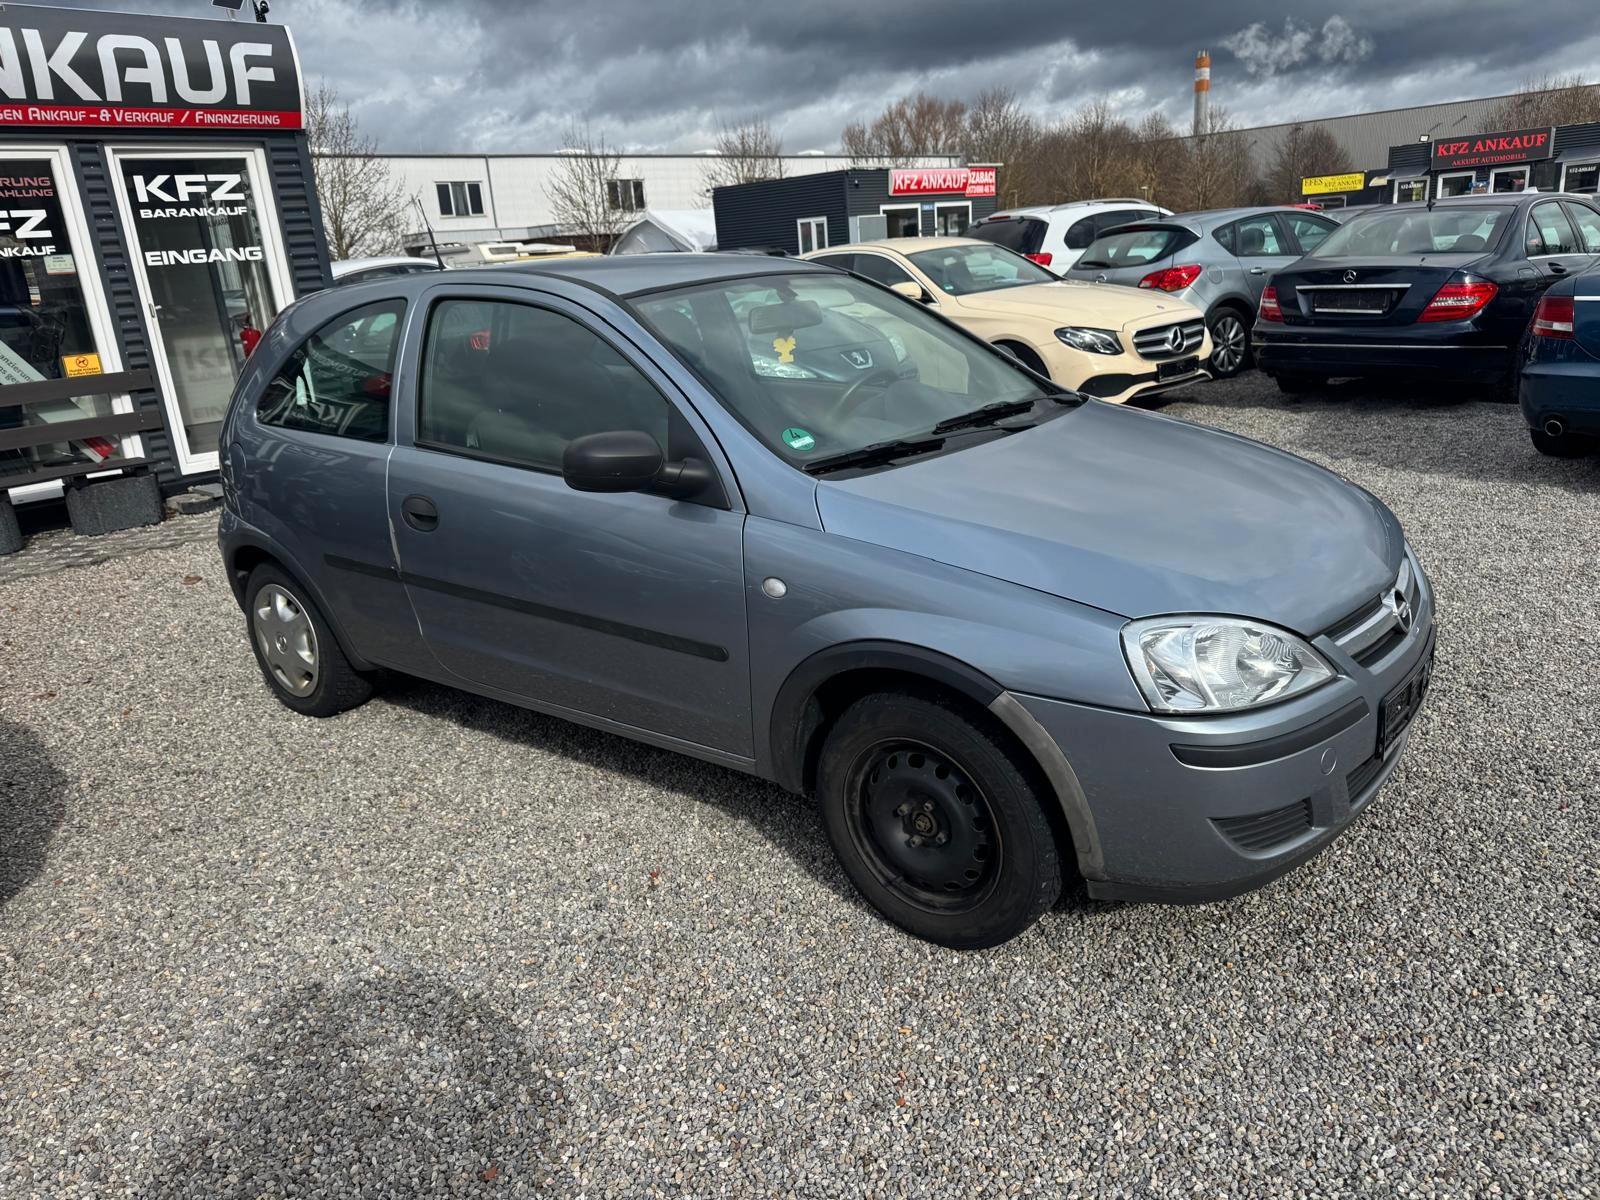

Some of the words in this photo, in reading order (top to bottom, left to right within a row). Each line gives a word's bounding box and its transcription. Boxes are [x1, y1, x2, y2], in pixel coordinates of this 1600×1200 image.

[195, 111, 281, 125] FINANZIERUNG
[1437, 141, 1470, 157] KFZ
[1473, 133, 1548, 153] ANKAUF
[1481, 152, 1527, 164] AUTOMOBILE
[133, 174, 245, 203] KFZ
[895, 174, 918, 190] KFZ
[921, 174, 967, 189] ANKAUF
[140, 206, 248, 219] BARANKAUF
[145, 246, 263, 266] EINGANG
